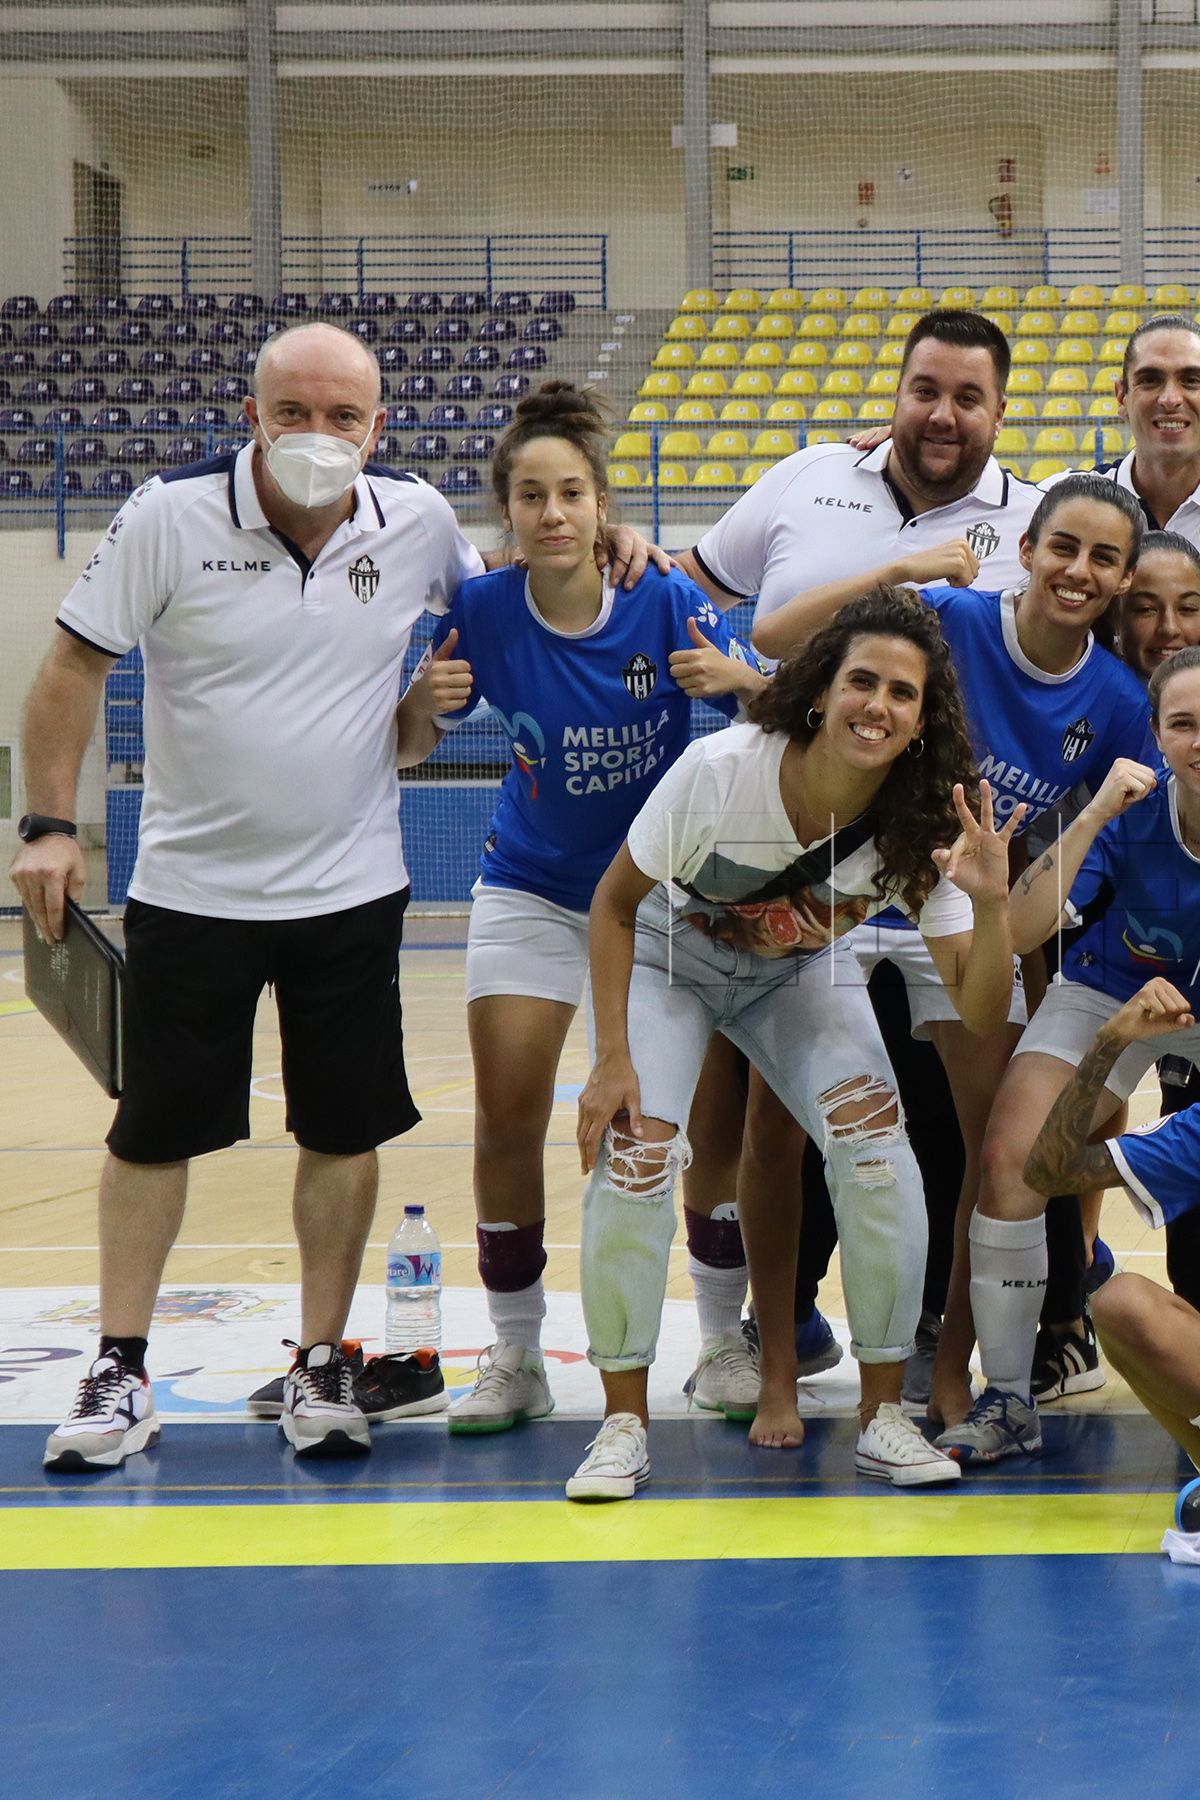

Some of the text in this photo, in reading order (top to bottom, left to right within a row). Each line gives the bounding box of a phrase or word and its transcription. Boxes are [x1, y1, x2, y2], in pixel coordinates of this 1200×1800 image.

[814, 496, 874, 514] KELME
[202, 560, 272, 572] KELME
[562, 709, 670, 748] MELILLA
[564, 738, 656, 773] SPORT
[1001, 1279, 1047, 1289] KELM
